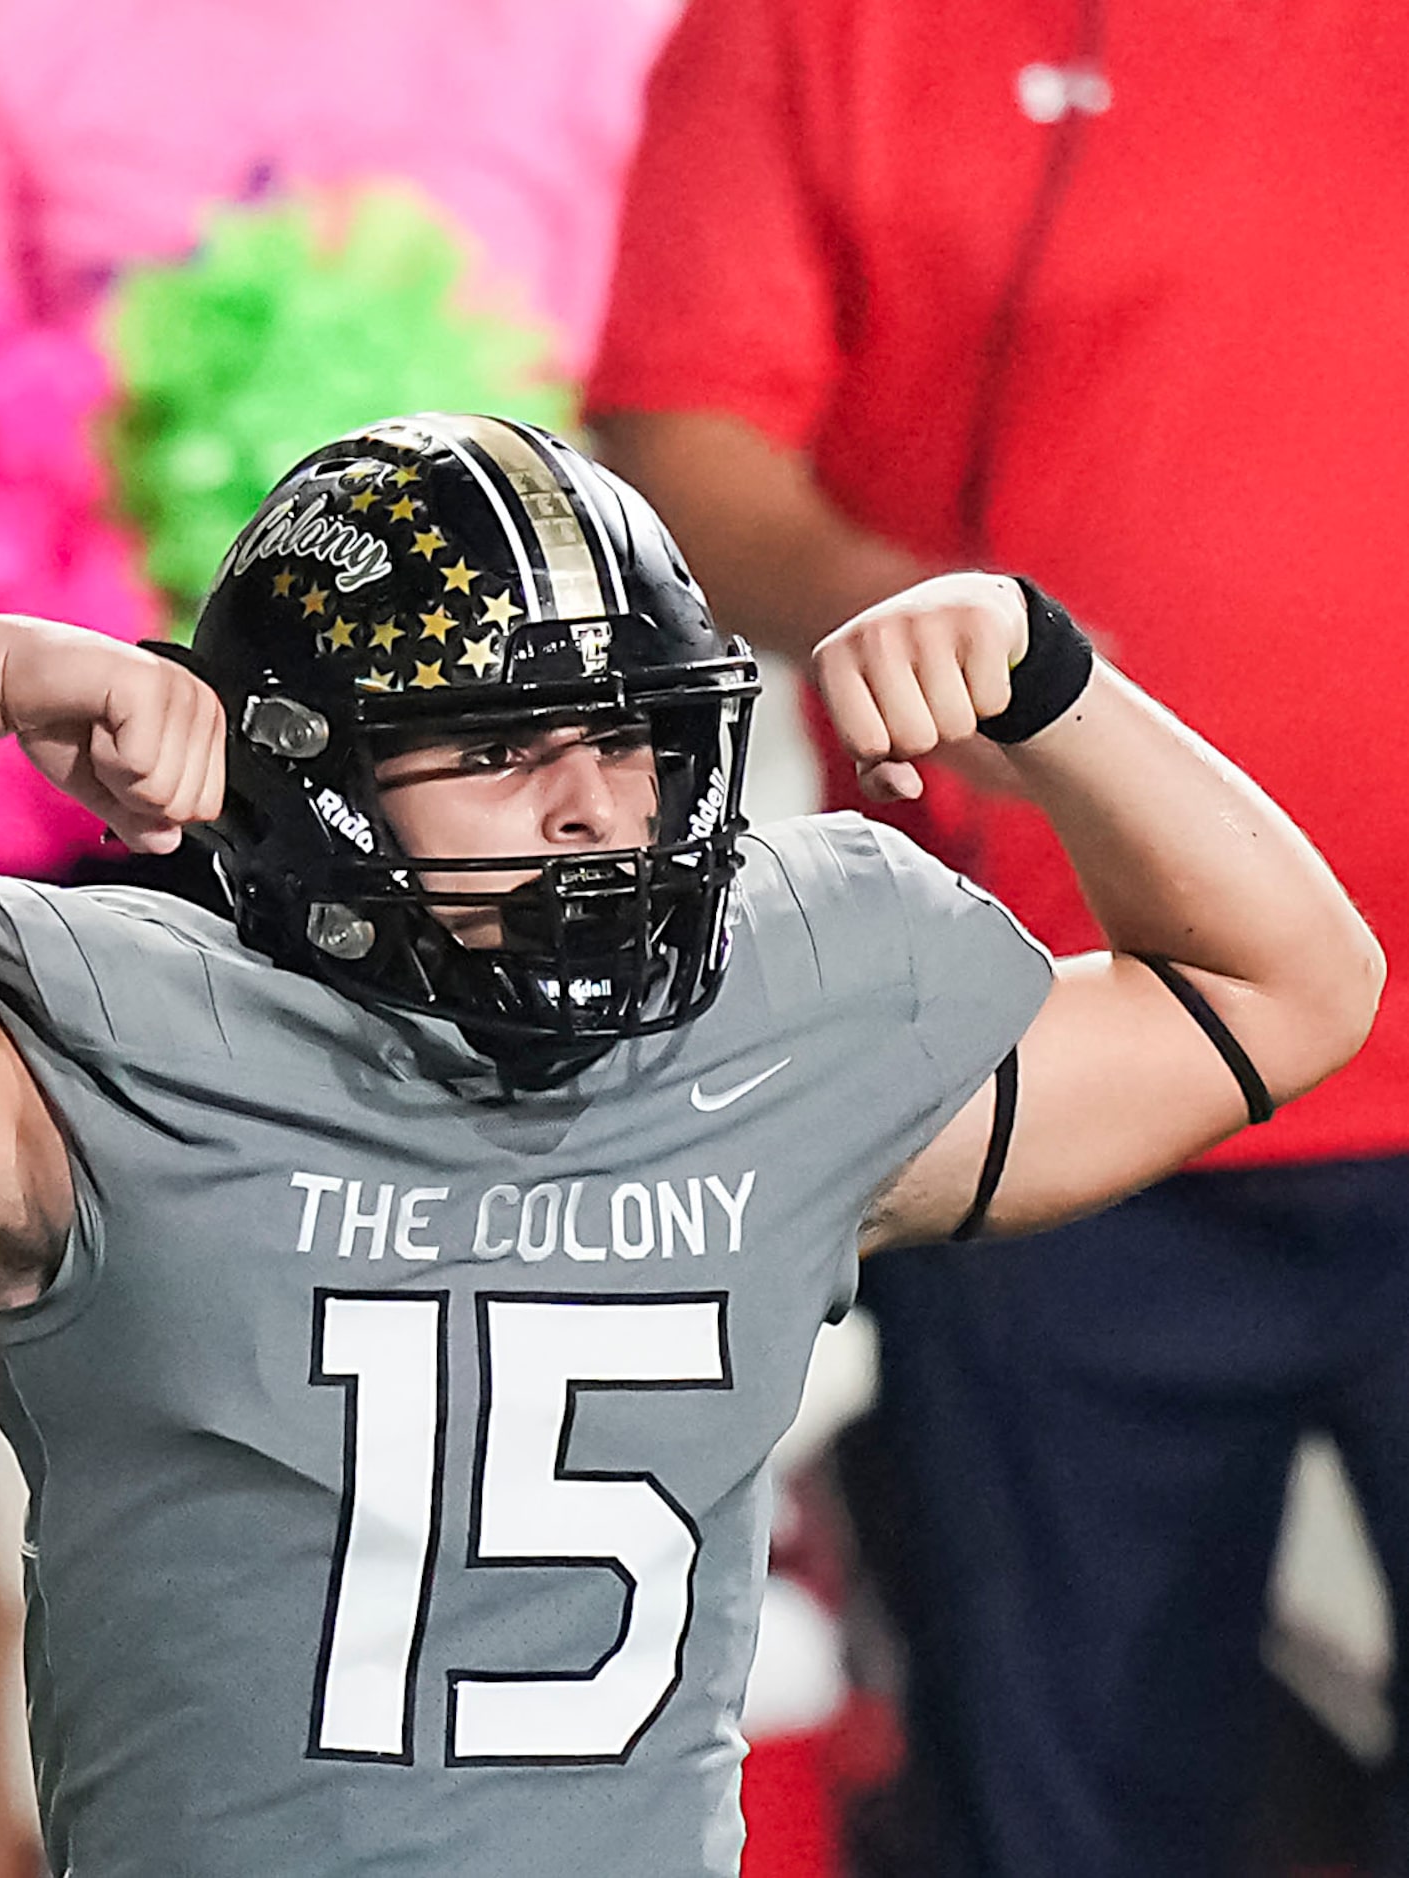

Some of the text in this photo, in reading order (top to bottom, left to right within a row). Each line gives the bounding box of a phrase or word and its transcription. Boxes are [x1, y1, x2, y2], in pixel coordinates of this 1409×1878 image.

[234, 494, 393, 593] Colony
[290, 1170, 756, 1262] THE COLONY
[306, 1287, 733, 1767] 15
